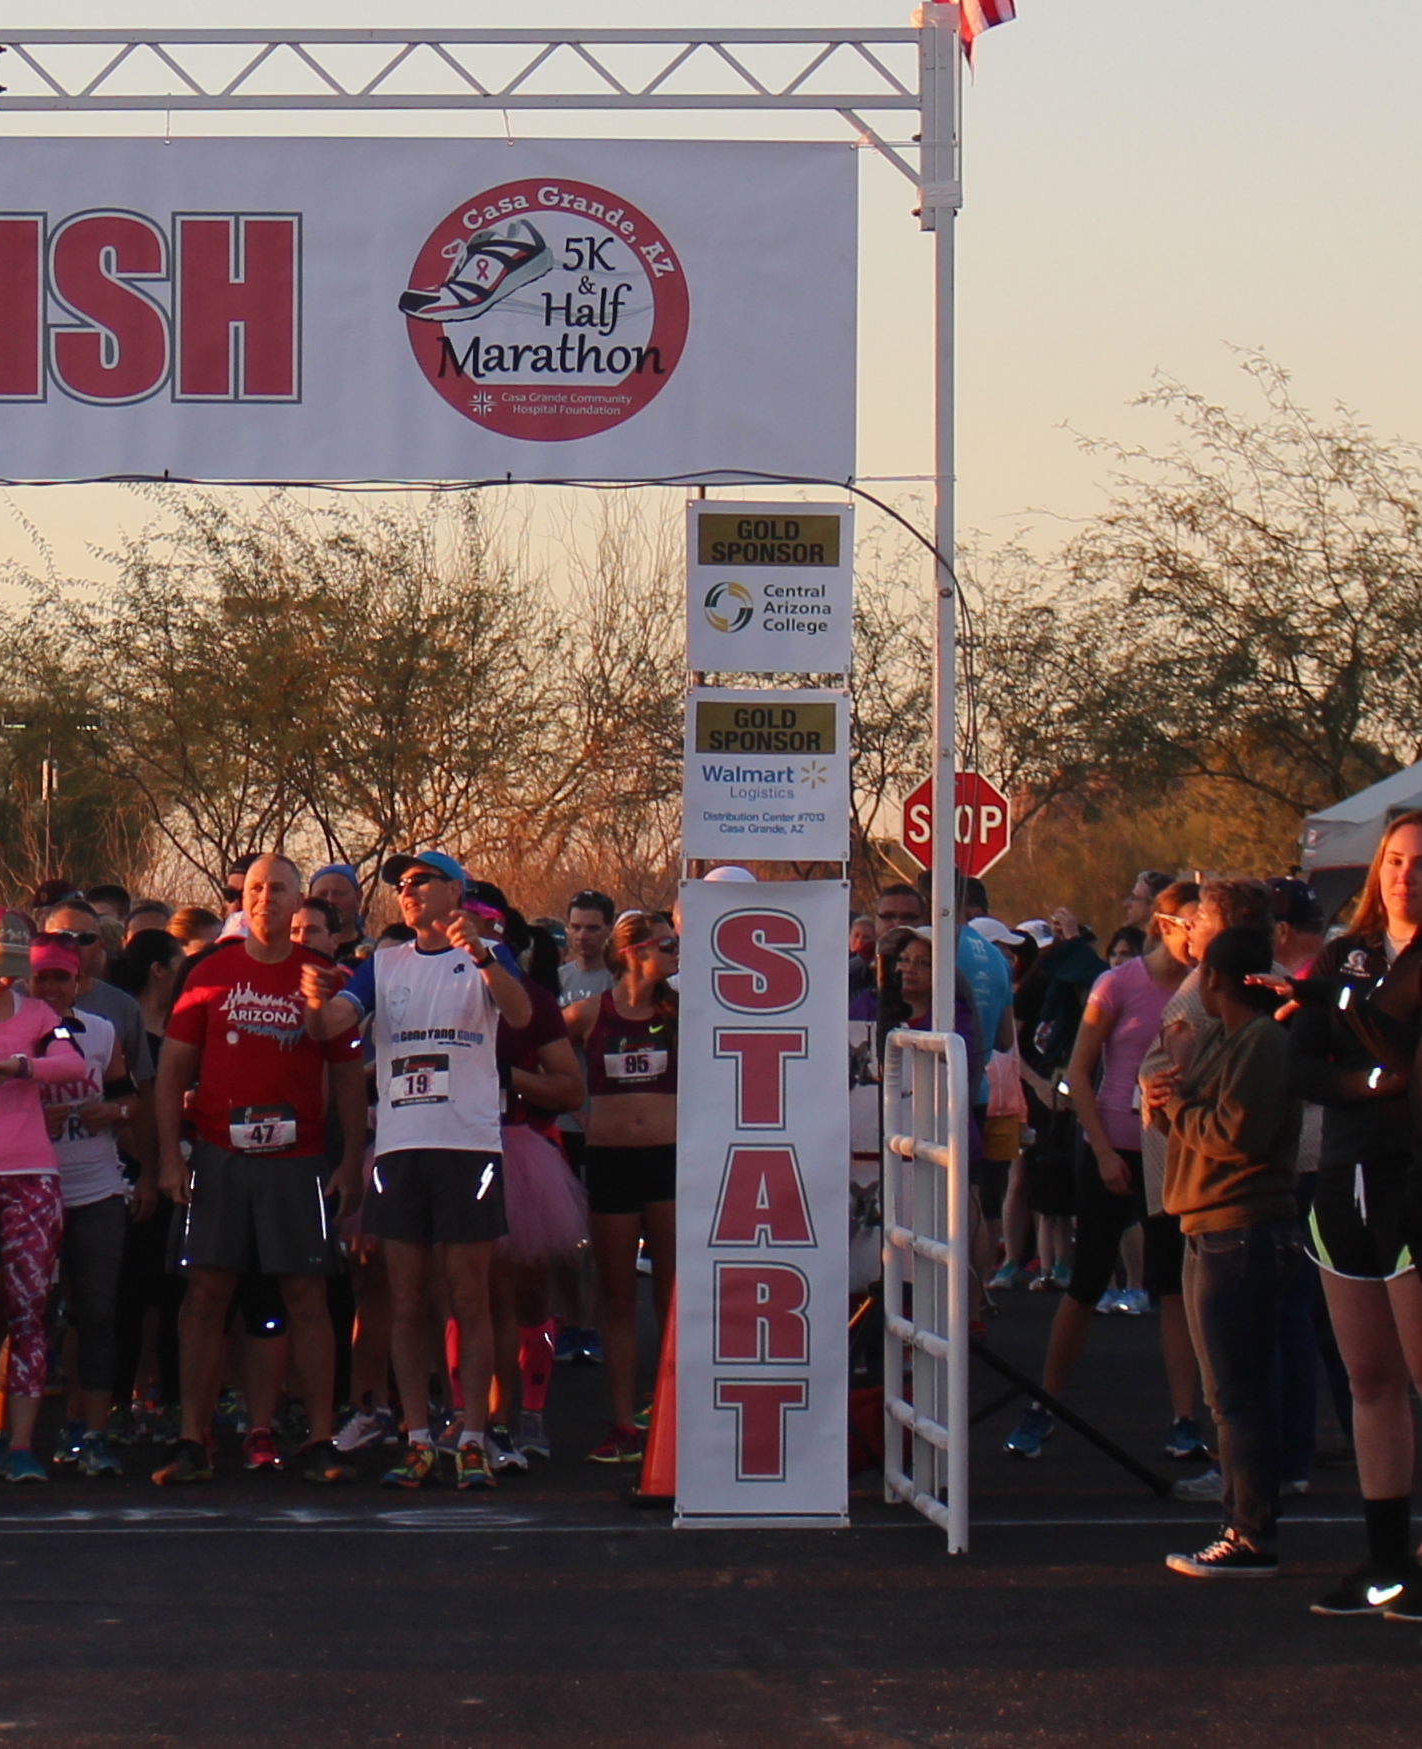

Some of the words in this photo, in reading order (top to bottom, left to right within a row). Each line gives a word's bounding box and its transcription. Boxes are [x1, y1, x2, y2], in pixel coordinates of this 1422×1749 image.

[462, 193, 529, 231] Casa
[537, 185, 638, 244] Grande,
[639, 240, 675, 279] AZ
[561, 236, 616, 272] 5K
[577, 275, 597, 296] &
[541, 282, 633, 337] Half
[436, 333, 666, 379] Marathon
[501, 392, 526, 404] Casa
[528, 392, 568, 404] Grande
[570, 393, 633, 406] Community
[512, 404, 557, 417] Hospital
[559, 404, 621, 416] Foundation
[737, 519, 800, 541] GOLD
[711, 541, 825, 564] SPONSOR
[763, 584, 826, 598] Central
[762, 601, 832, 615] Arizona
[762, 618, 829, 635] College
[734, 708, 797, 729] GOLD
[709, 730, 821, 751] SPONSOR
[701, 764, 795, 784] Walmart
[730, 785, 795, 802] Logistics
[703, 811, 759, 822] Distribution
[762, 812, 795, 822] Center
[797, 812, 825, 822] #7013
[908, 803, 1003, 845] SOP
[719, 823, 745, 834] Casa
[748, 823, 788, 835] Grande,
[790, 824, 805, 834] AZ
[227, 1009, 298, 1025] ARIZONA
[625, 1054, 649, 1074] 95
[406, 1073, 428, 1096] 19
[251, 1124, 275, 1144] 47
[707, 907, 818, 1483] START
